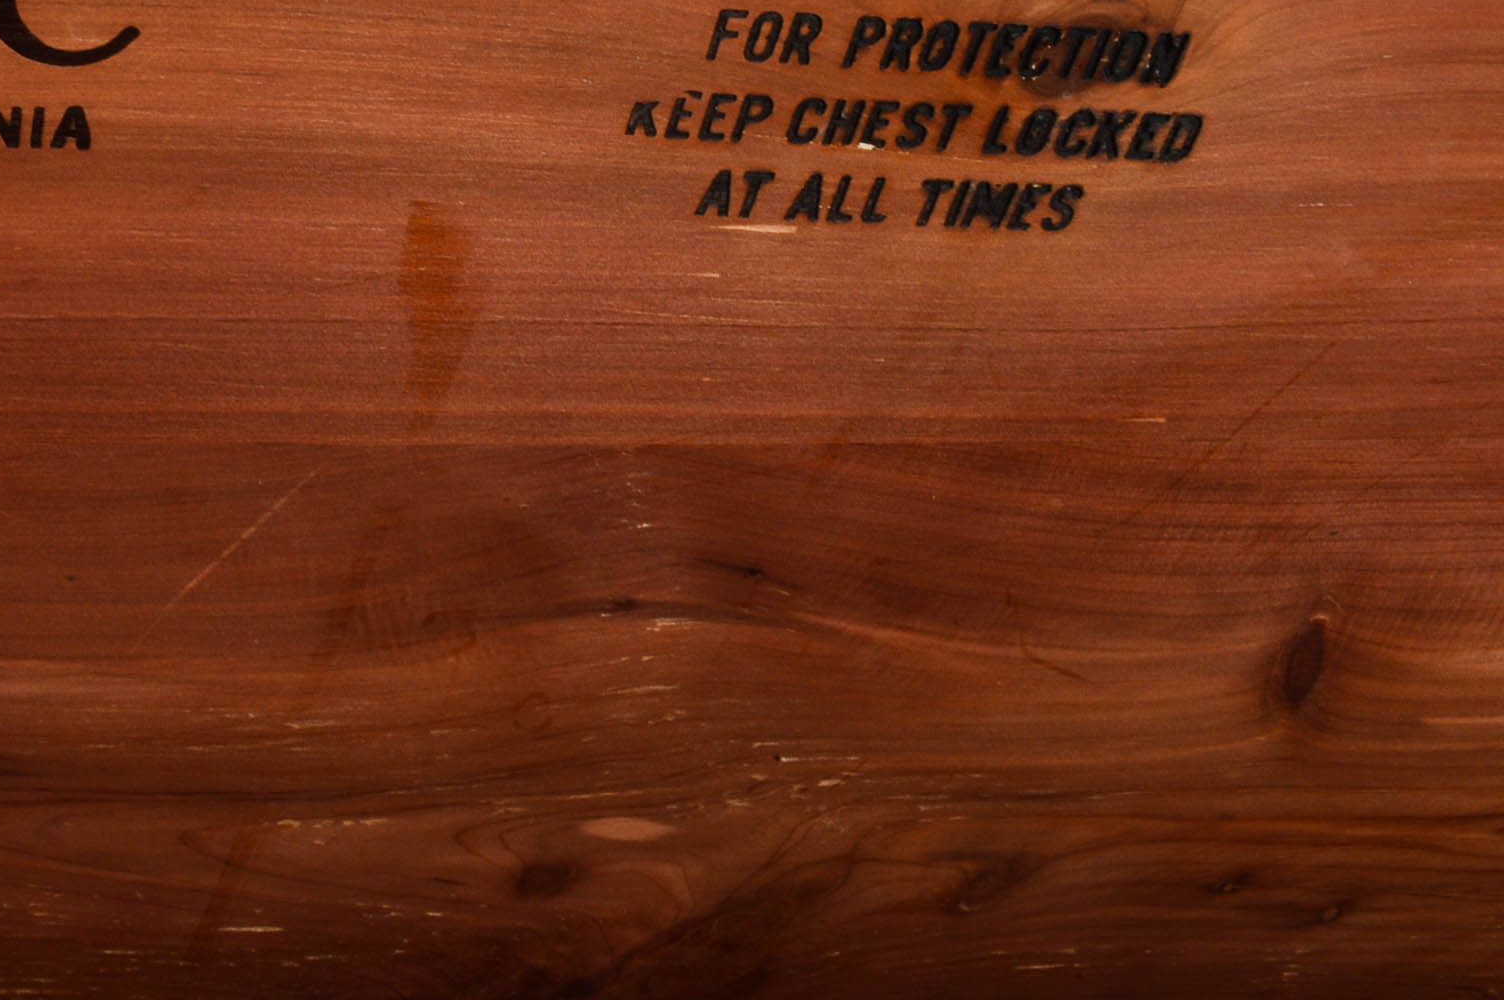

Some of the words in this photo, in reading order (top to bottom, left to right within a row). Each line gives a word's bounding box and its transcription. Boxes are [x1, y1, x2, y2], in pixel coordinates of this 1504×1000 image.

[706, 9, 823, 65] FOR
[841, 16, 1191, 89] PROTECTION
[624, 90, 774, 143] KEEP
[786, 97, 971, 152] CHEST
[982, 107, 1204, 163] LOCKED
[695, 170, 775, 219] AT
[783, 172, 887, 224] ALL
[915, 178, 1085, 231] TIMES
